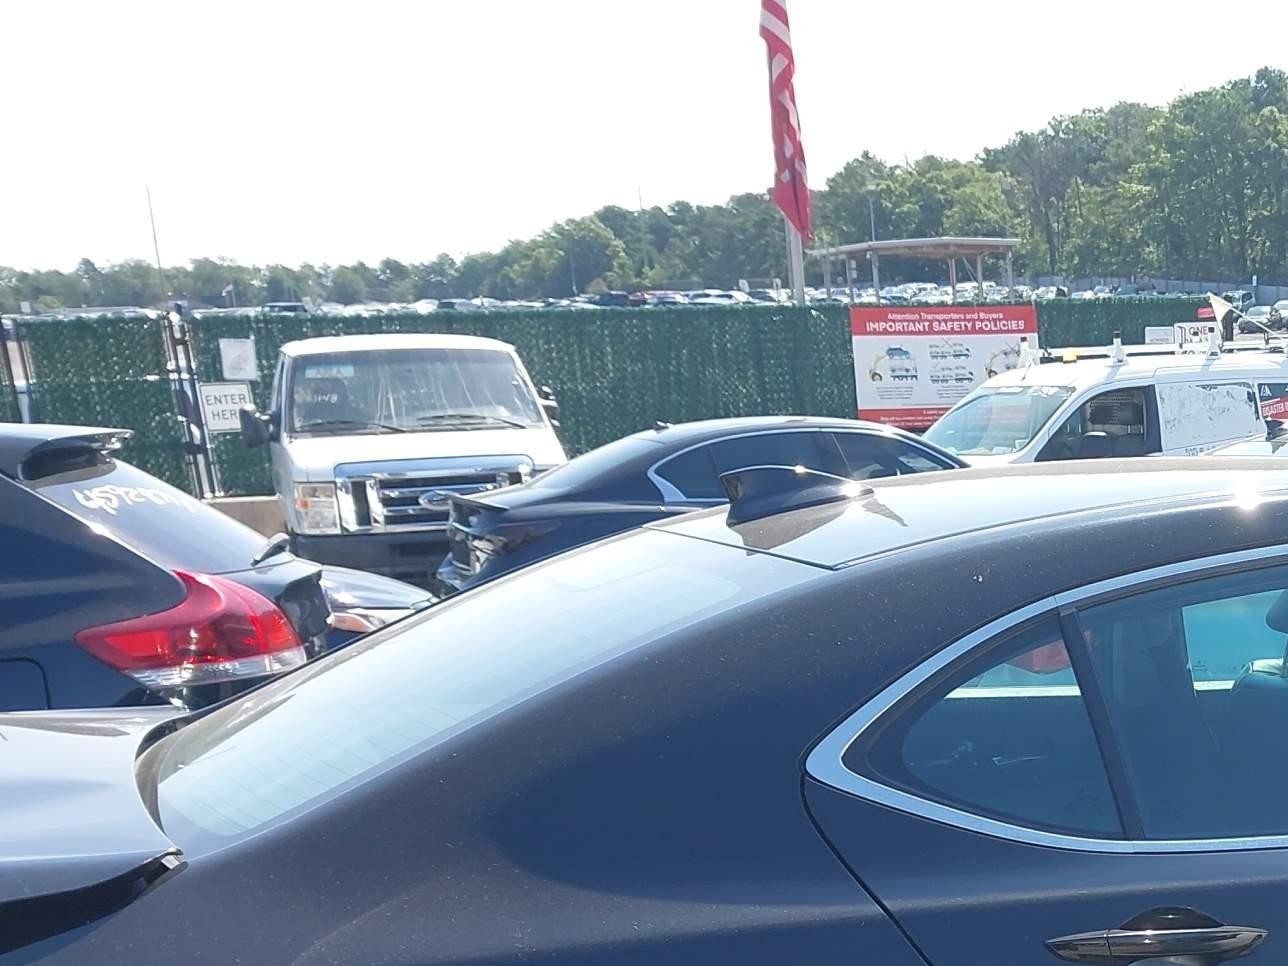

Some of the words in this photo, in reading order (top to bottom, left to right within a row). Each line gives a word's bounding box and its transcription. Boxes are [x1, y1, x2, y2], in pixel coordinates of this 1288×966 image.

[920, 312, 965, 321] Transporters
[966, 312, 978, 320] and
[979, 312, 1004, 321] Buyers
[866, 321, 930, 332] IMPORTANT
[932, 321, 973, 332] SAFETY
[975, 320, 1025, 331] POLICIES
[205, 394, 247, 406] ENTER
[212, 409, 238, 420] HER
